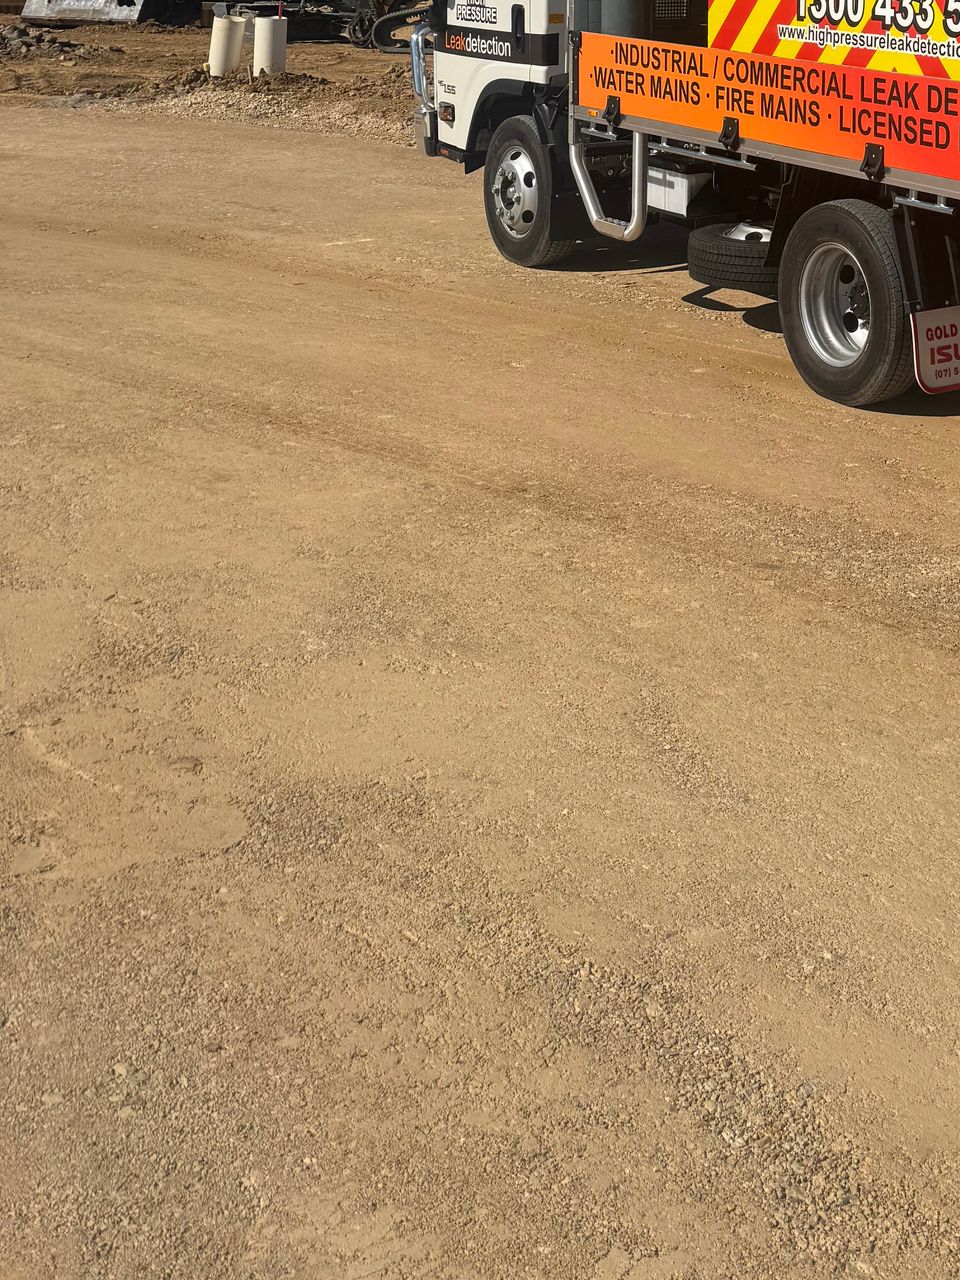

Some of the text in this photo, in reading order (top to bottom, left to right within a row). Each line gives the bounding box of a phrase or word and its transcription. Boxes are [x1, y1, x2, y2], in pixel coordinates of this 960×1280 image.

[457, 5, 497, 24] PRESSURE
[445, 32, 511, 57] Leakdetection
[723, 57, 854, 101] COMMERCIAL
[859, 74, 920, 111] LEAK
[650, 75, 700, 106] MAINS
[715, 86, 756, 115] FIRE
[760, 92, 821, 128] MAINS
[839, 106, 950, 150] LICENSED
[925, 323, 958, 341] GOLD
